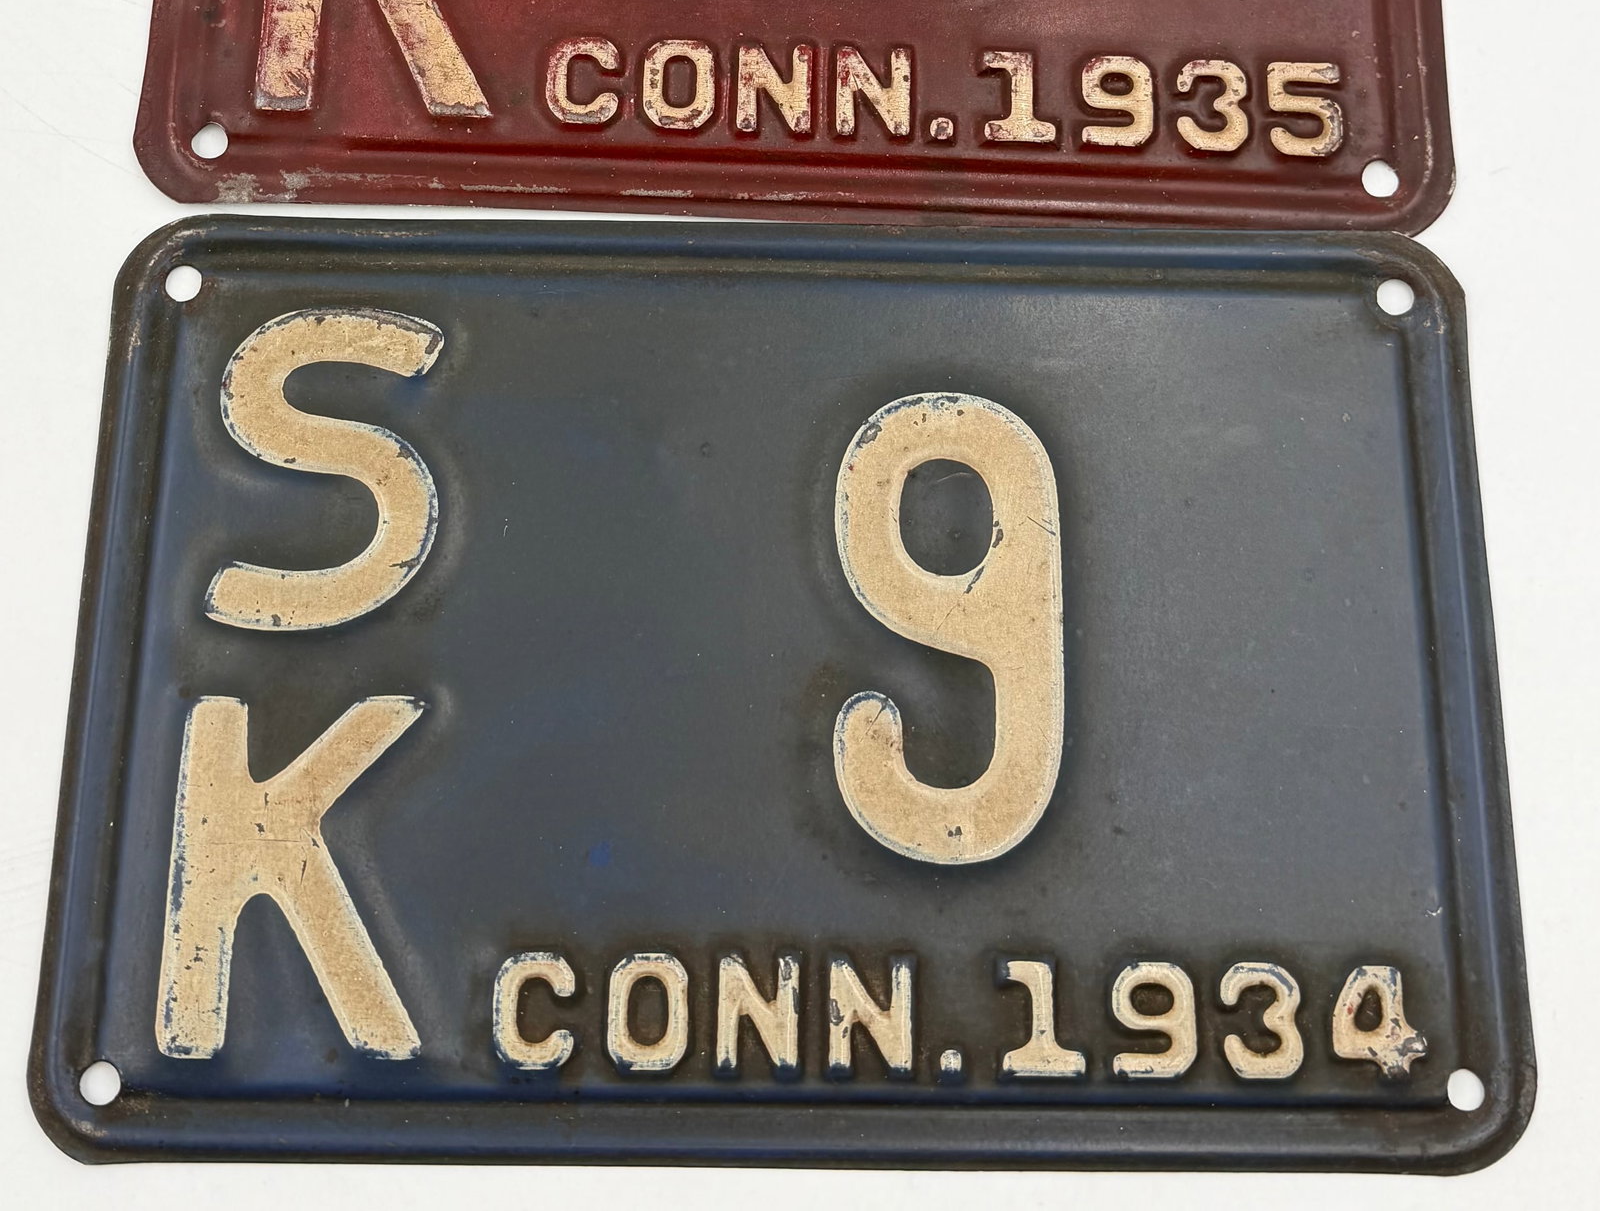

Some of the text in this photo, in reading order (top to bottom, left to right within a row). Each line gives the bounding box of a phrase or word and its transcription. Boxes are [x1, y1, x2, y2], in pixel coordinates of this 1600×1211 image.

[205, 309, 445, 632] S
[833, 394, 1065, 865] 9
[154, 695, 423, 1061] K
